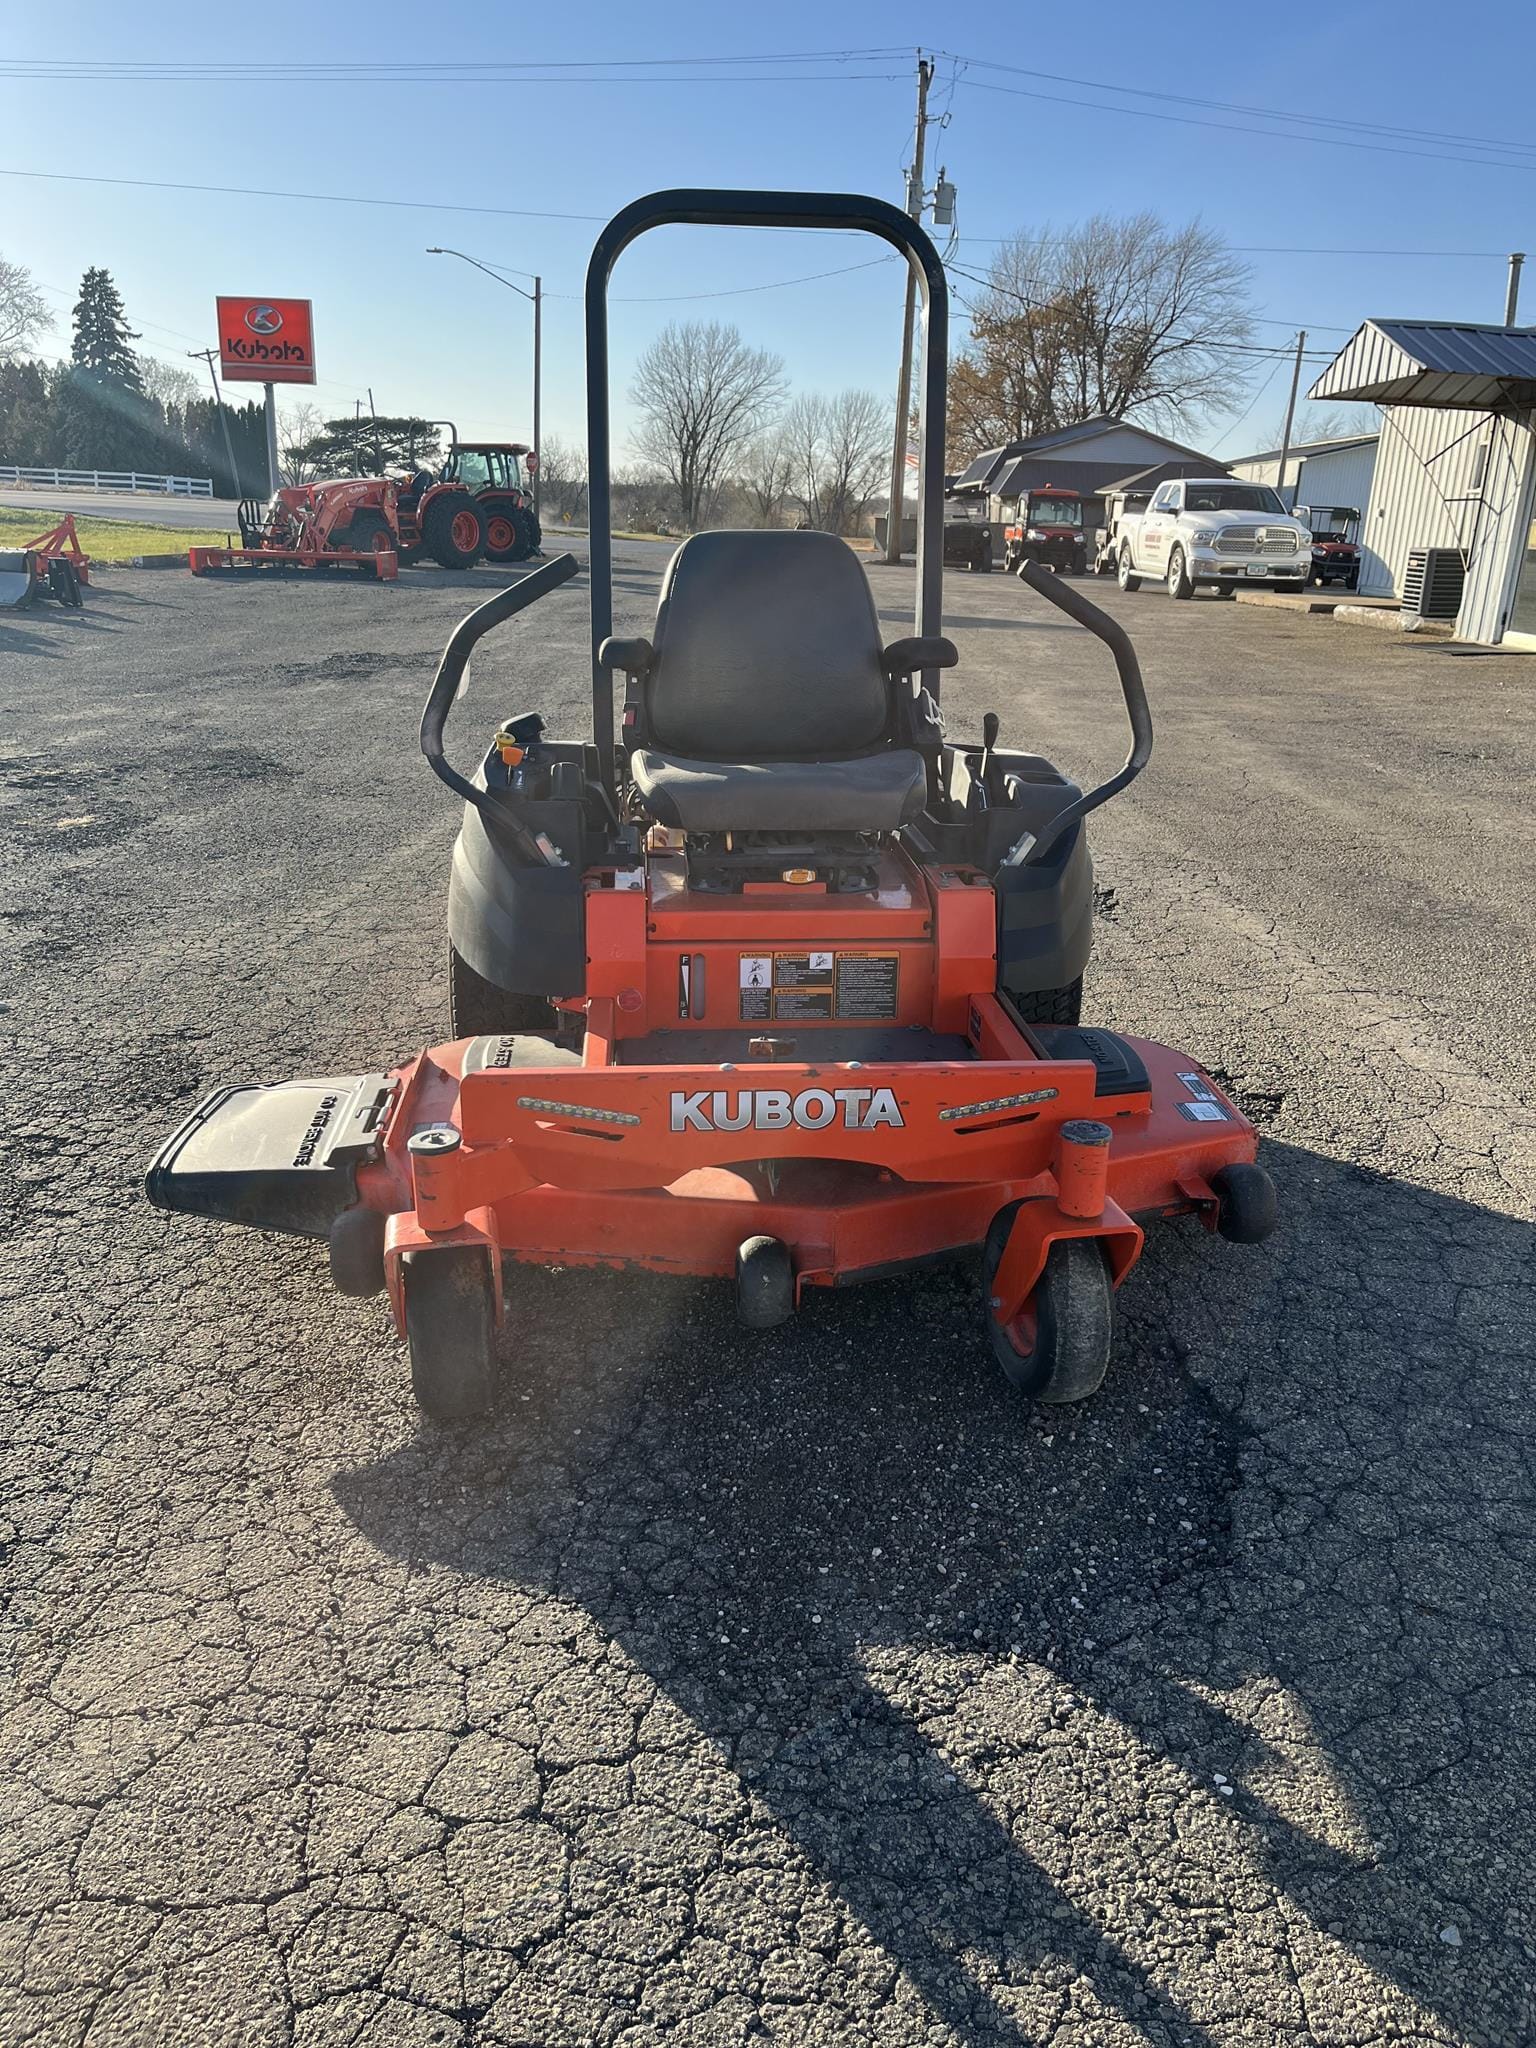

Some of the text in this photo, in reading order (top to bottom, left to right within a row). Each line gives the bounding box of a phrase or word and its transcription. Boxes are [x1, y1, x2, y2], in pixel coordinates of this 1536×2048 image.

[227, 338, 305, 361] Kubota
[682, 956, 689, 964] F
[681, 1009, 688, 1017] E
[670, 1087, 905, 1131] KUBOTA
